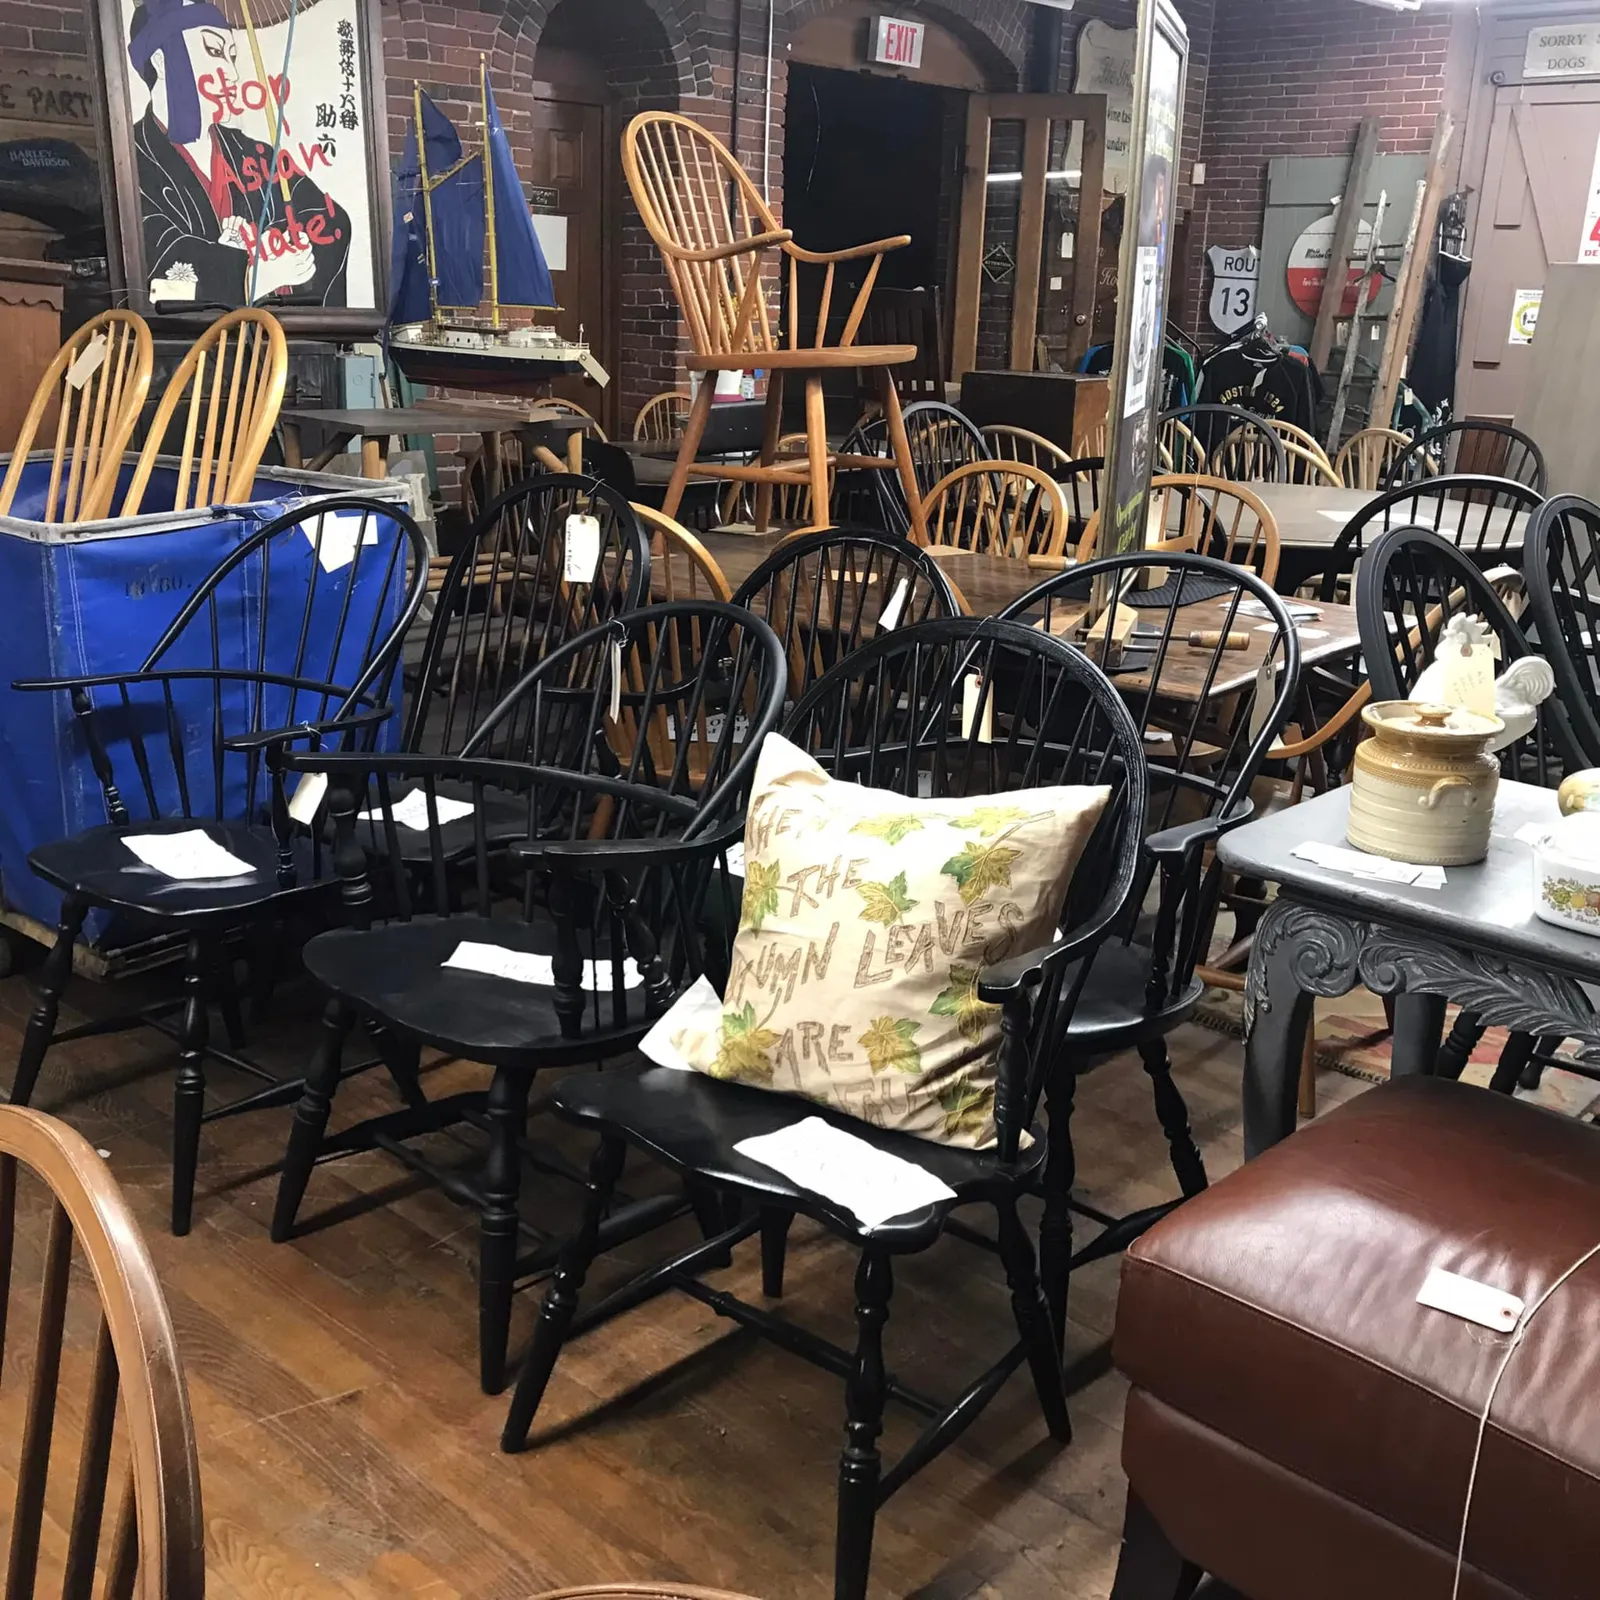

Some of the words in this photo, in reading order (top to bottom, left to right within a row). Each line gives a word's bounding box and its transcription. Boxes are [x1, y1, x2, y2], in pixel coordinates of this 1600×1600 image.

[885, 23, 917, 63] EXIT
[1539, 34, 1587, 48] SORRY
[1547, 56, 1587, 70] DOGS
[198, 67, 290, 136] Stop
[22, 157, 71, 167] DAVIDSON
[214, 142, 333, 193] Asian
[239, 192, 342, 266] Hate!
[1224, 256, 1260, 273] ROU
[786, 854, 870, 918] THE
[853, 900, 1025, 988] LEAVES
[774, 1020, 854, 1089] ARE
